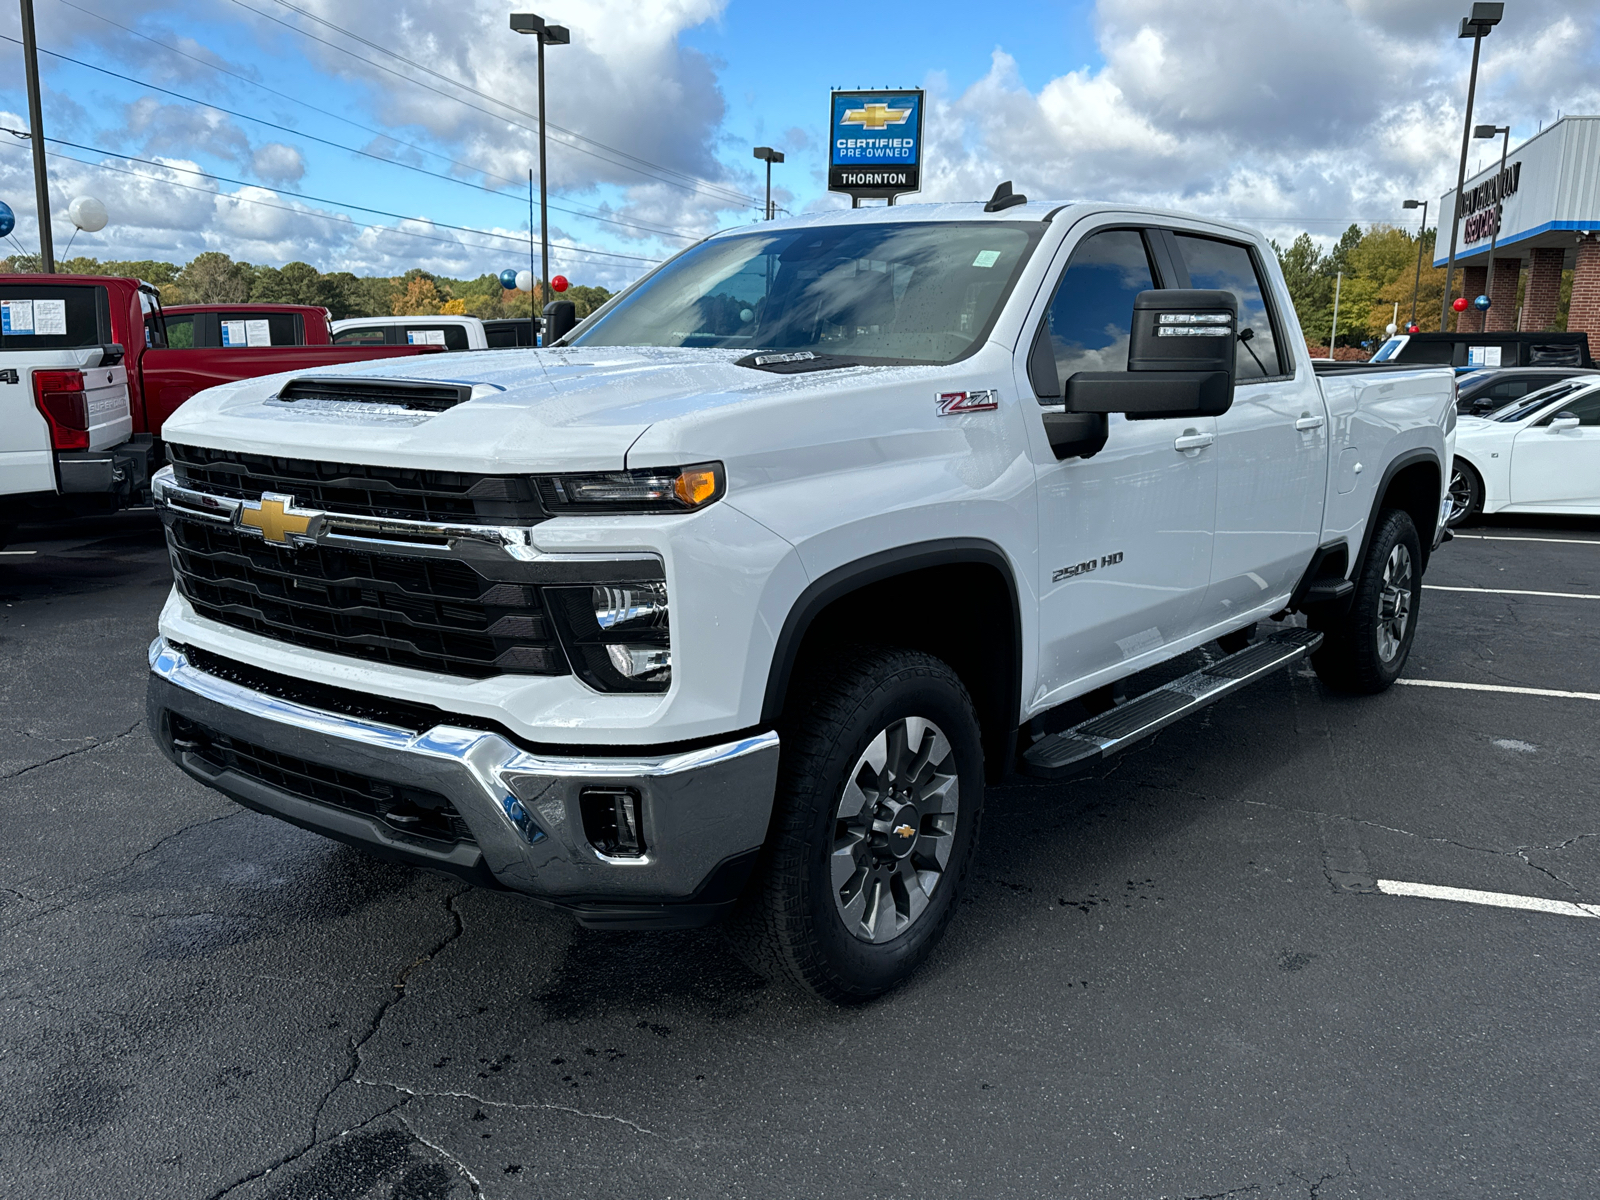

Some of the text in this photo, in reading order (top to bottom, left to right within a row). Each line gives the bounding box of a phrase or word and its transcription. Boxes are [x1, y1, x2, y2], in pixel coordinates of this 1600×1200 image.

[836, 138, 914, 148] CERTIFIED
[840, 148, 909, 157] PRE-OWNED
[841, 173, 906, 184] THORNTON
[1459, 162, 1522, 219] OHN THORNON
[1464, 213, 1481, 245] USED
[935, 389, 998, 417] Z71
[1052, 551, 1124, 583] 2500 HD
